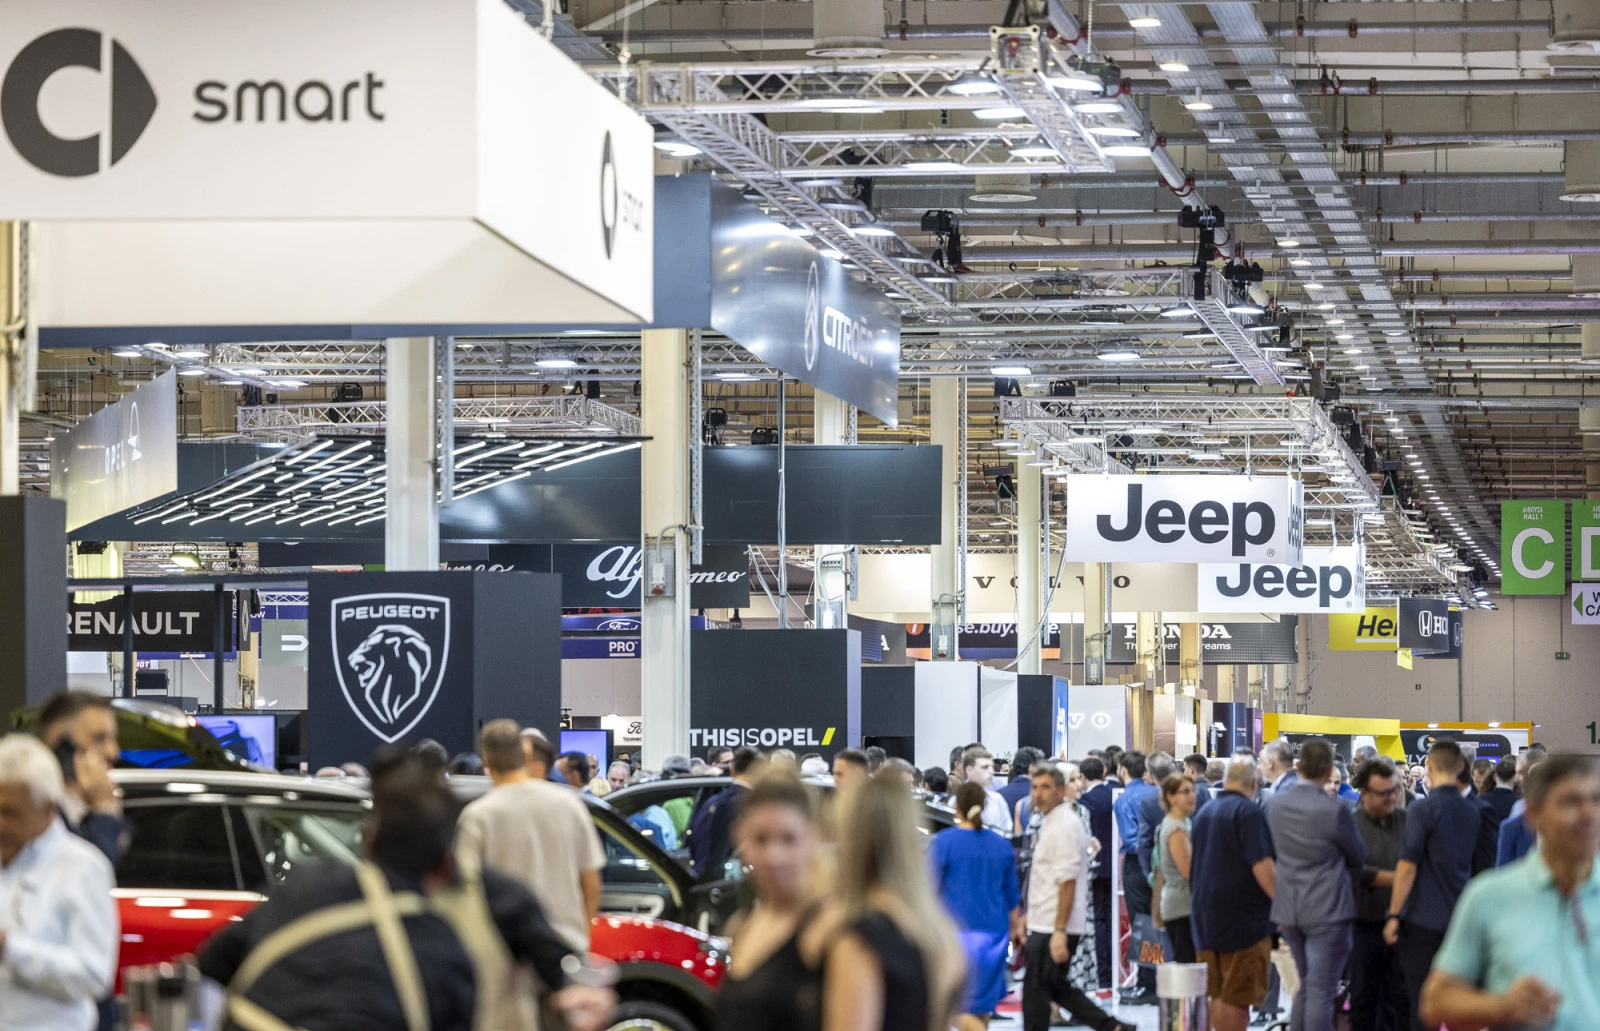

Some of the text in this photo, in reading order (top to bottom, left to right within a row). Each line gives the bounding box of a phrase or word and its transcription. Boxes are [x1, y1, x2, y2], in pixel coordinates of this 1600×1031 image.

[193, 72, 386, 124] smart
[1096, 483, 1275, 556] Jeep
[586, 546, 746, 598] Alf meo
[1511, 527, 1555, 579] C
[1216, 563, 1352, 607] Jeep
[341, 605, 440, 621] PEUGEOT
[609, 641, 635, 652] PRO
